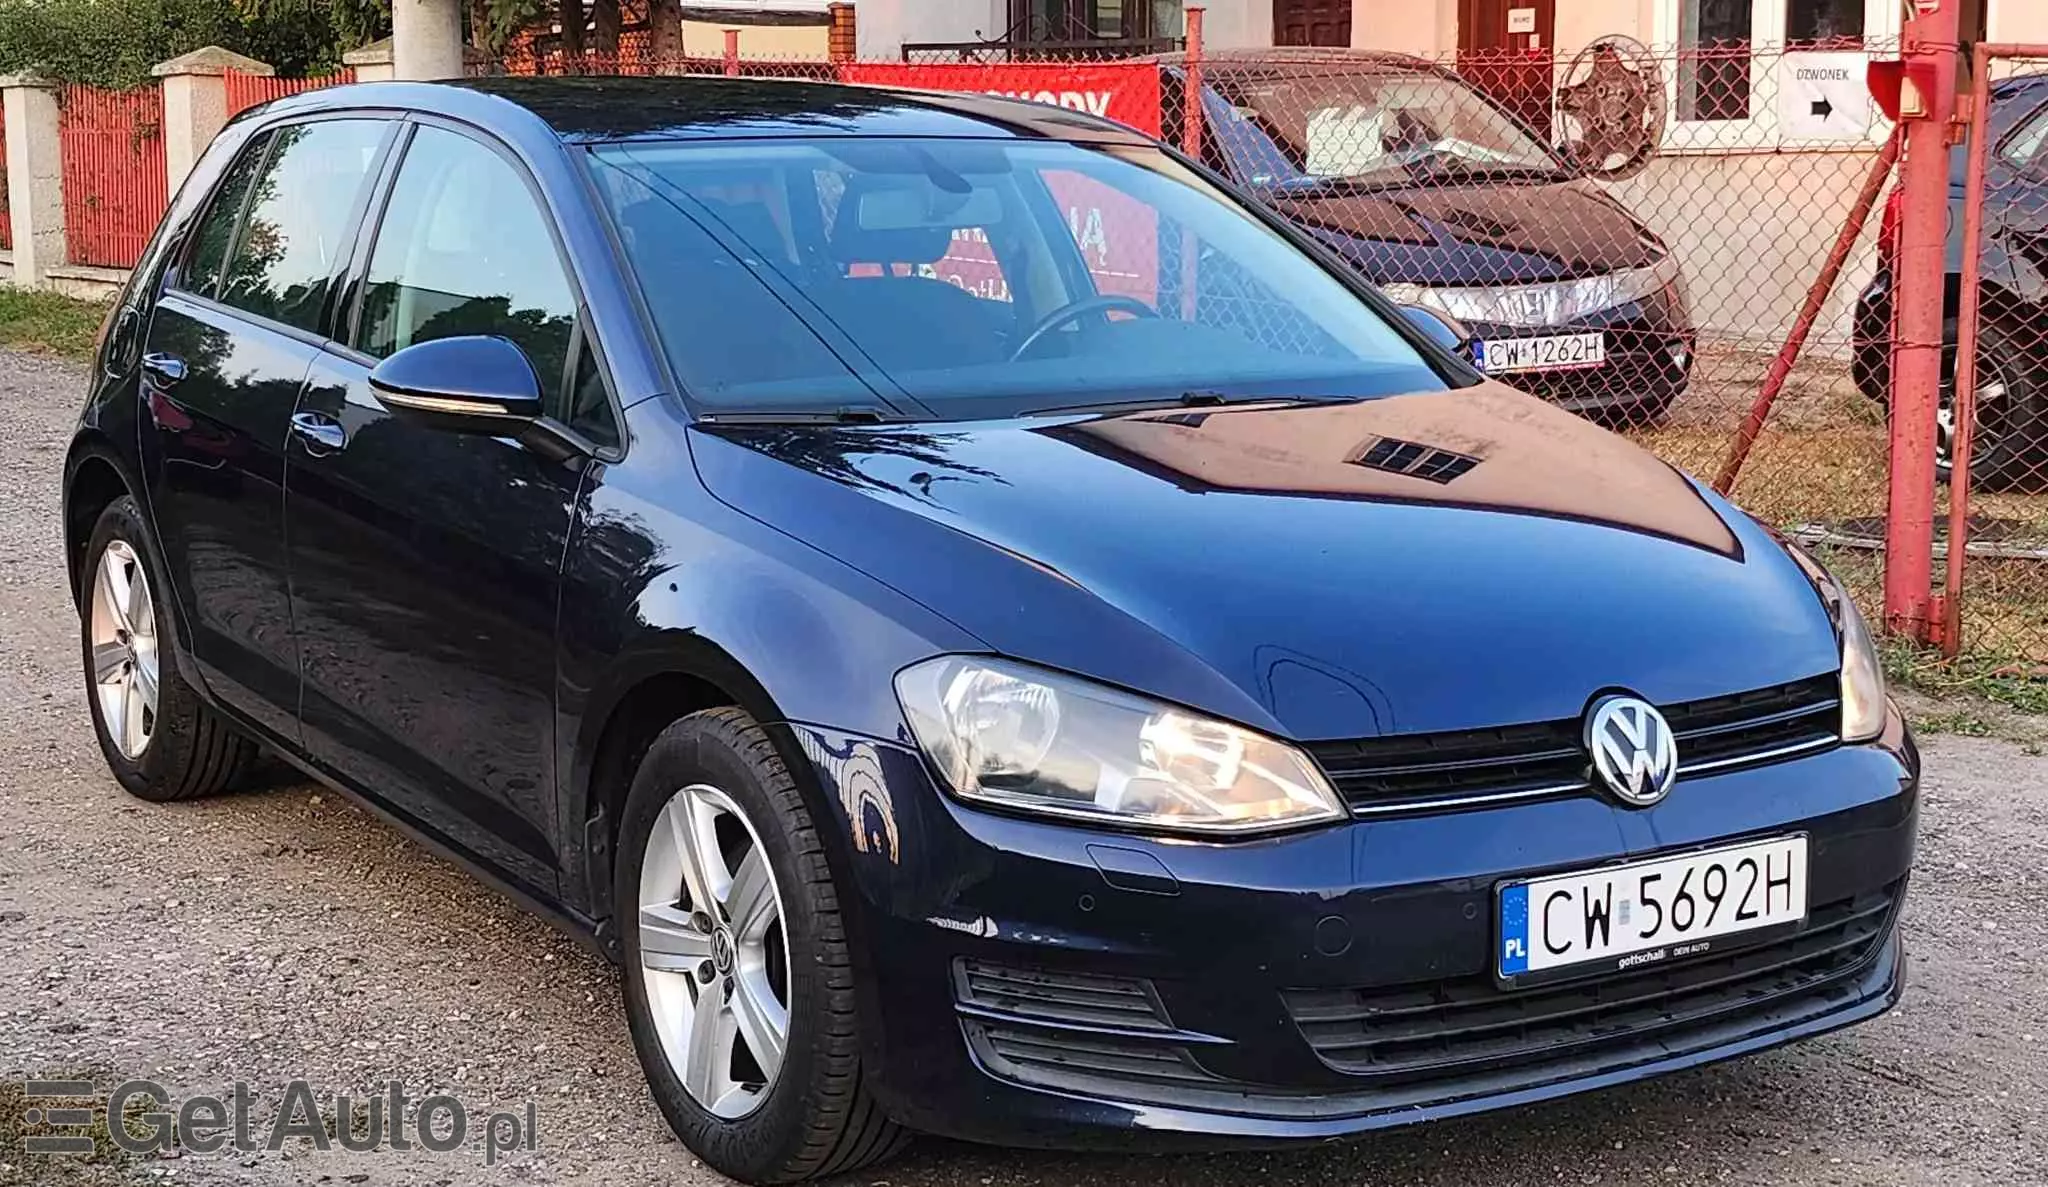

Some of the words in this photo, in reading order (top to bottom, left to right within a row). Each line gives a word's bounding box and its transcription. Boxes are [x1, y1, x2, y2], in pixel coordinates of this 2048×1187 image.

[1796, 68, 1849, 80] DZWONEK
[1490, 343, 1518, 366] CW
[1532, 337, 1599, 364] 1262H
[1543, 881, 1612, 955] CW
[1639, 850, 1792, 939] 5692H
[1505, 939, 1526, 959] PL
[1691, 942, 1711, 953] AUTO
